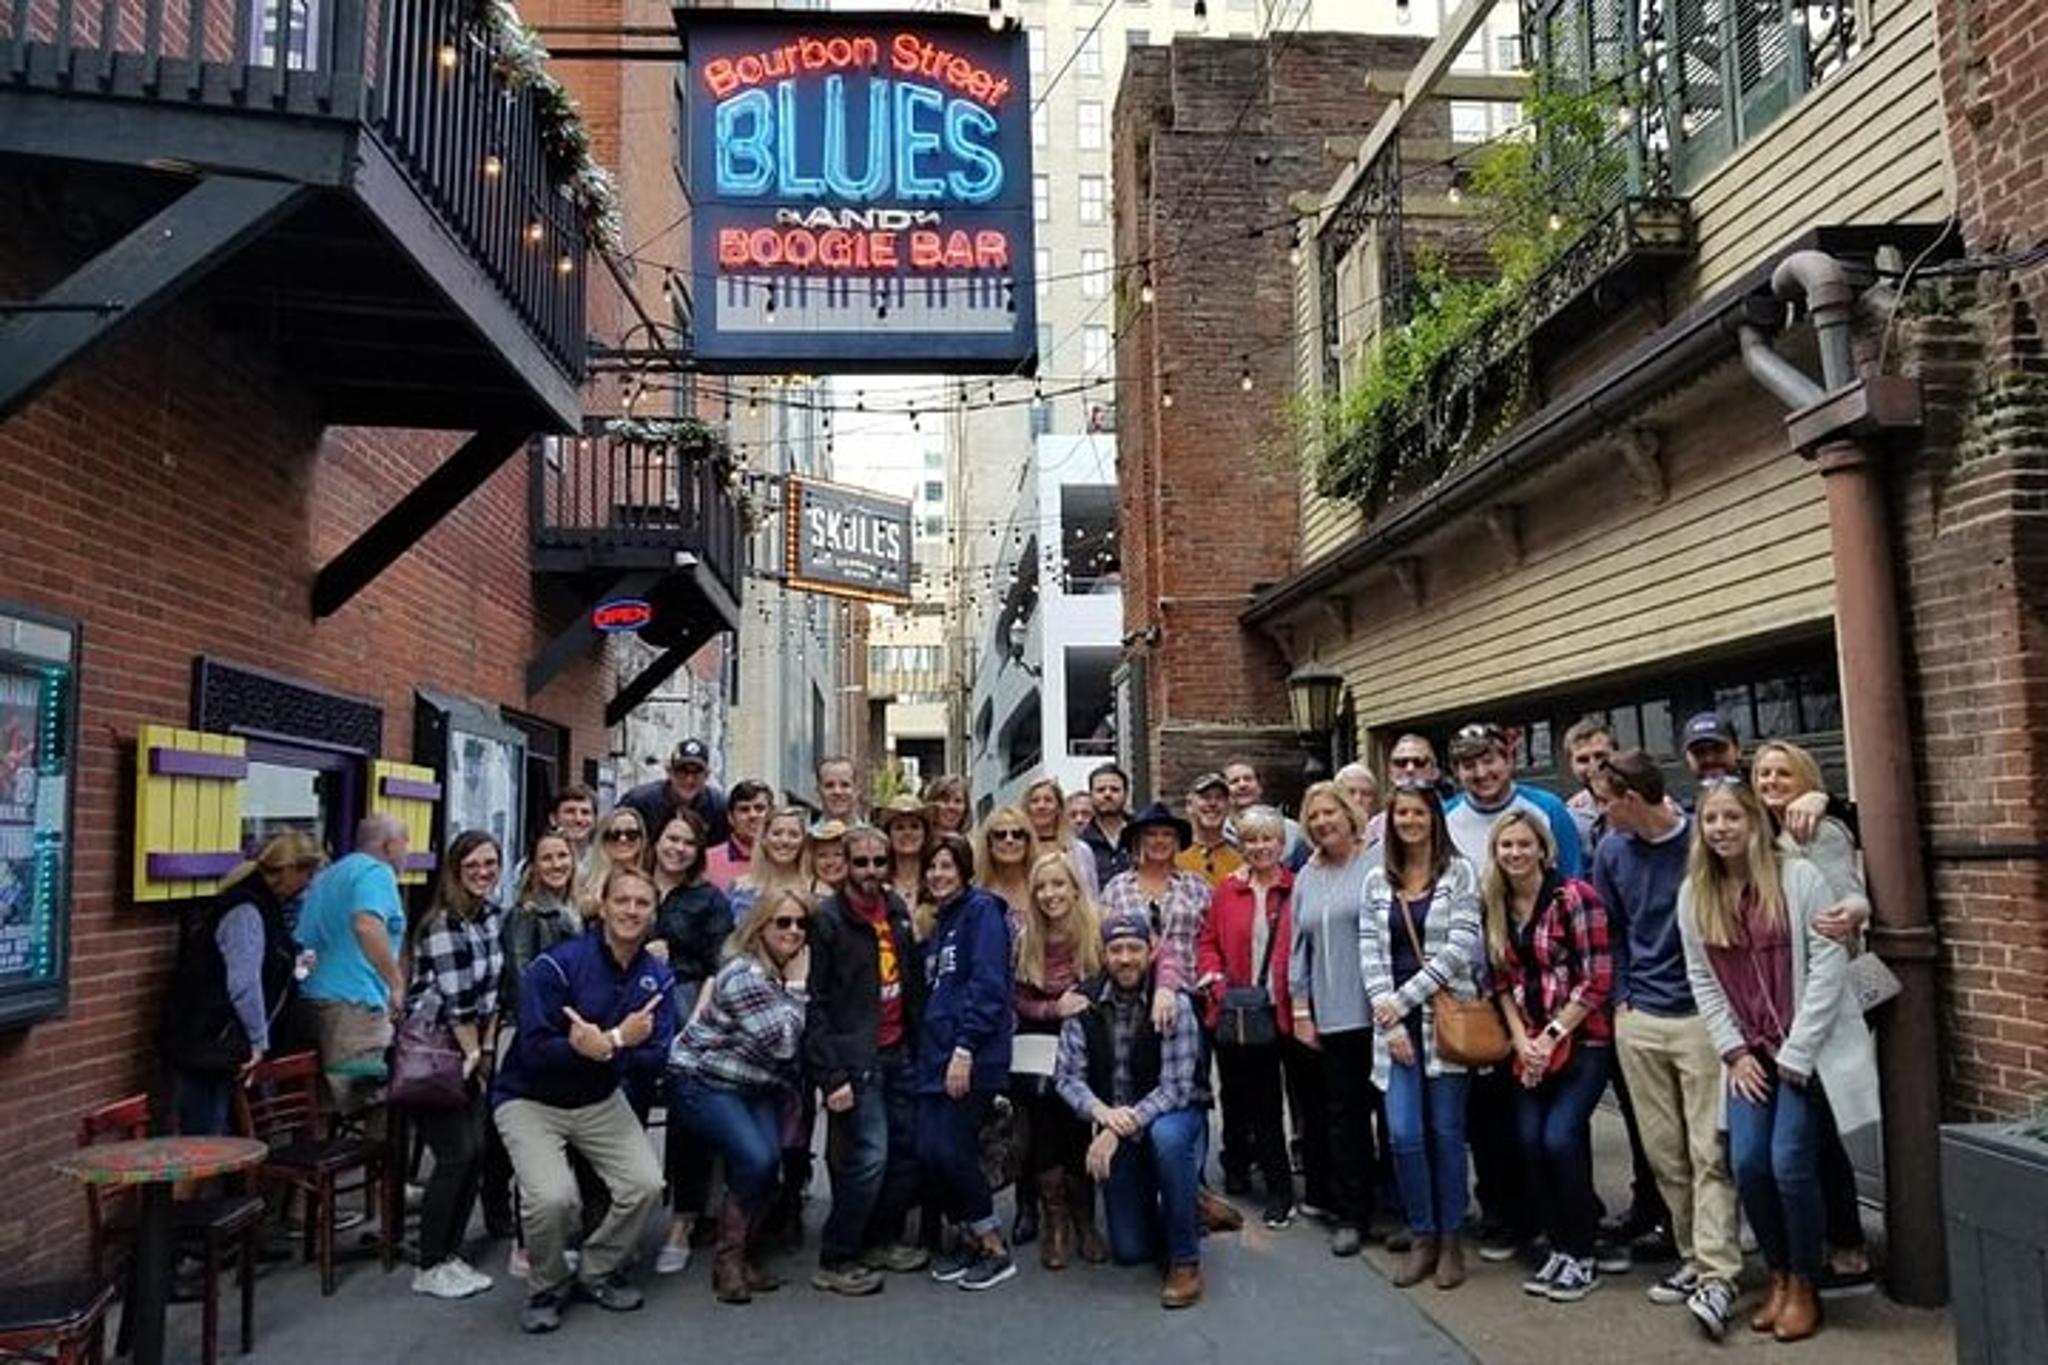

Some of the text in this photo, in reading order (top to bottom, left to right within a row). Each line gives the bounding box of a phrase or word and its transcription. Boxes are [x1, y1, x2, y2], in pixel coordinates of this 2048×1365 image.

[703, 32, 1010, 107] Bourbon Street
[715, 73, 1004, 201] BLUES
[803, 207, 915, 230] AND
[717, 228, 1009, 268] BOOGIE BAR
